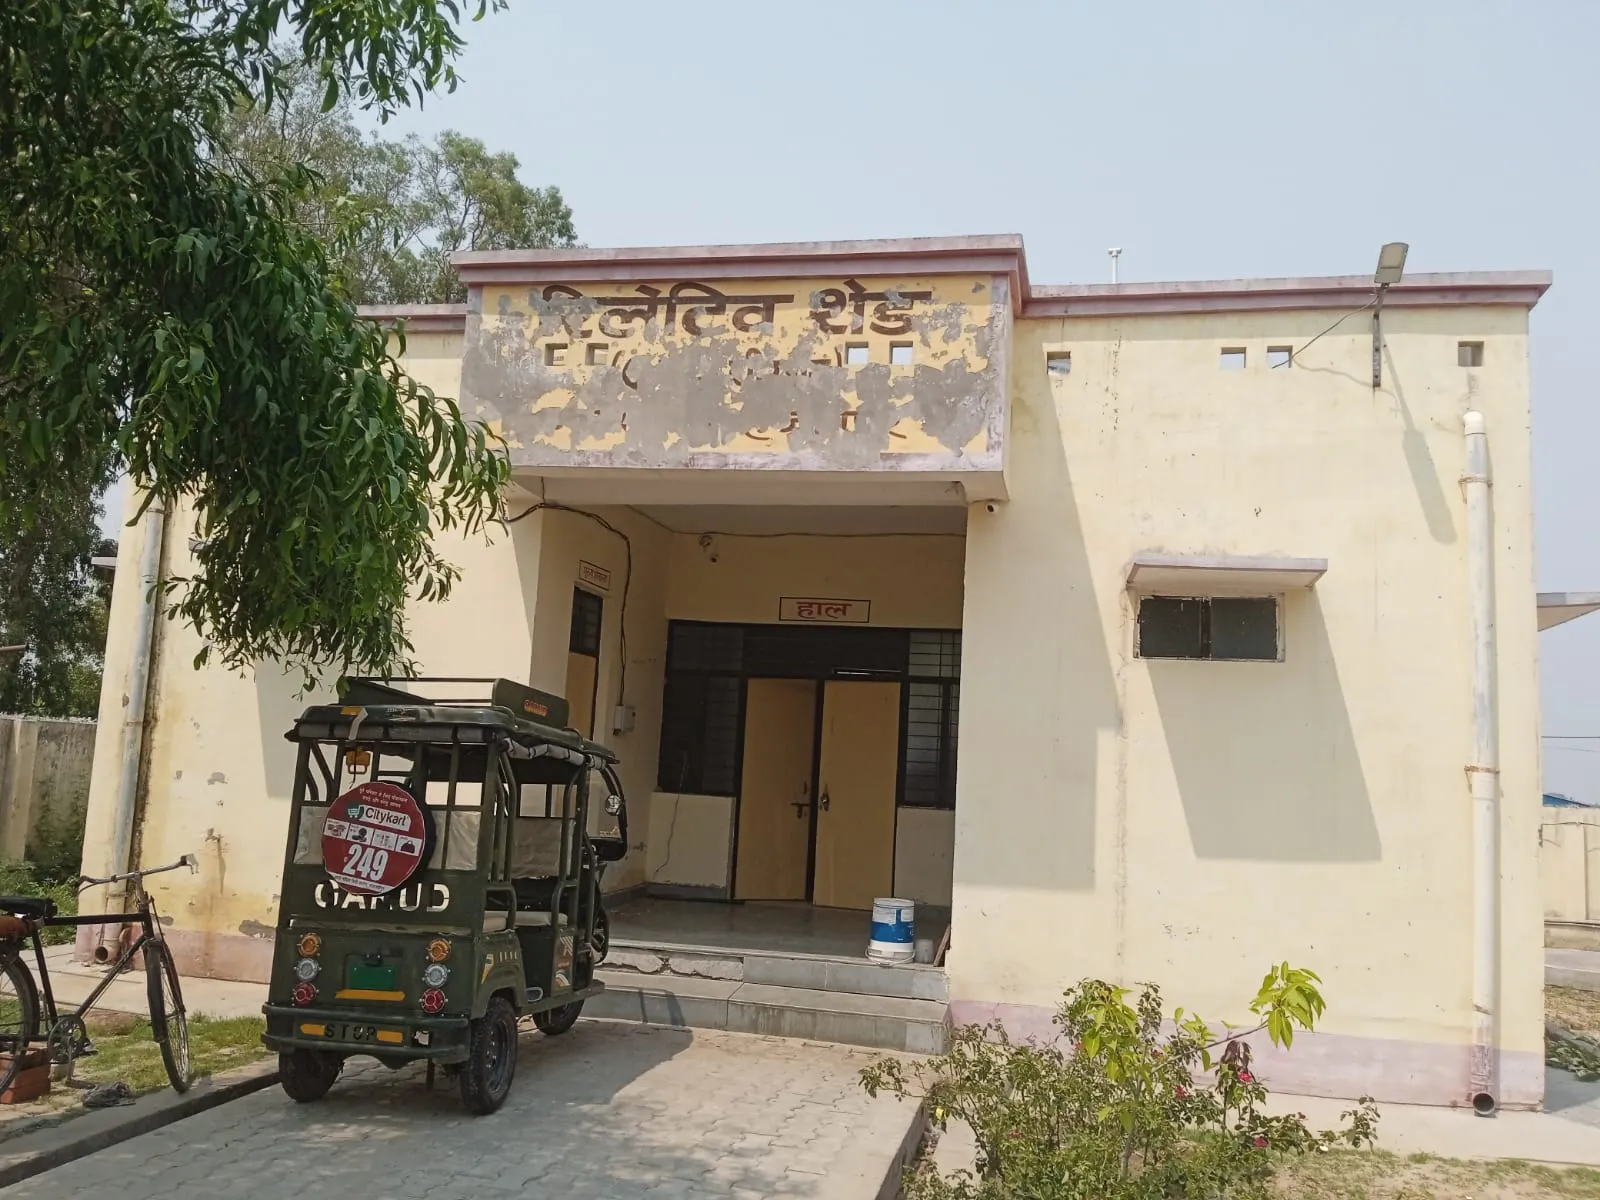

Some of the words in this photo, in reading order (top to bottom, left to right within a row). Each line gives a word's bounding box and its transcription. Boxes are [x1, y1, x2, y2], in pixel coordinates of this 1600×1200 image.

[809, 278, 932, 336] शेड
[796, 600, 853, 619] हाल
[365, 807, 407, 826] Citykart
[342, 843, 389, 881] 249
[324, 1023, 377, 1041] STOP
